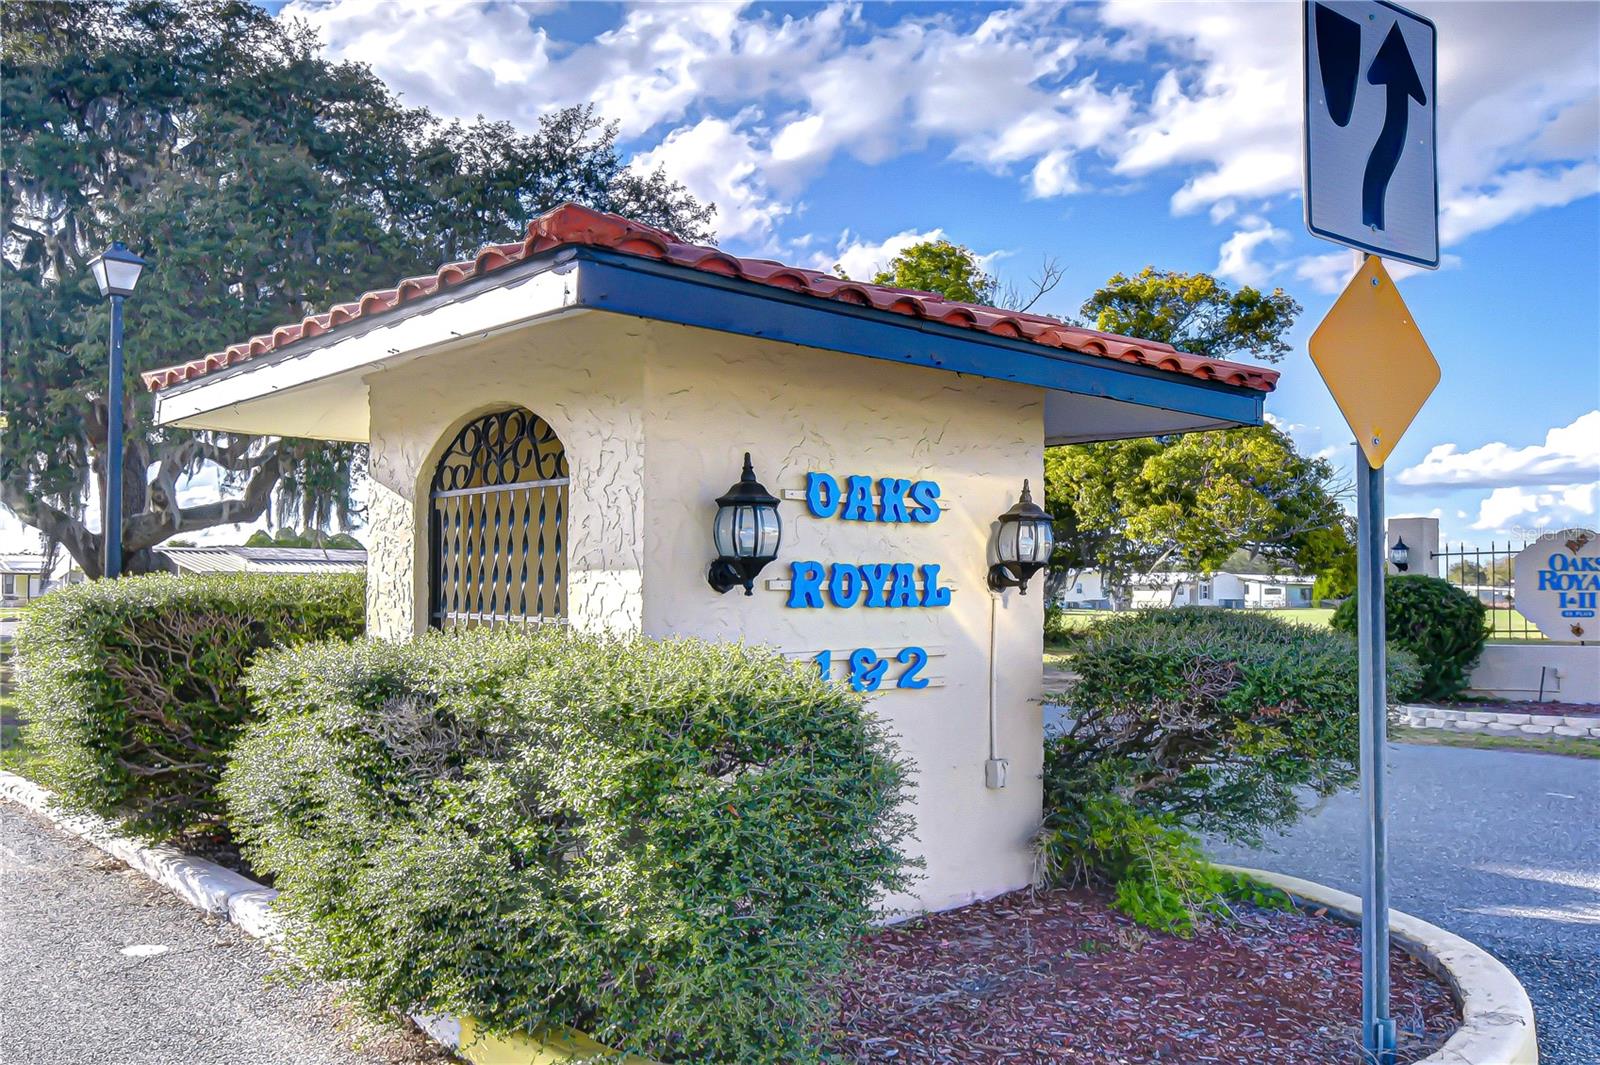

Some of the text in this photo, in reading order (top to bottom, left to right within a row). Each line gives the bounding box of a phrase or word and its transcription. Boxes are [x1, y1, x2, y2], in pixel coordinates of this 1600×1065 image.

[806, 472, 942, 523] OAKS
[786, 561, 952, 609] ROYAL
[815, 646, 930, 692] 1 & 2
